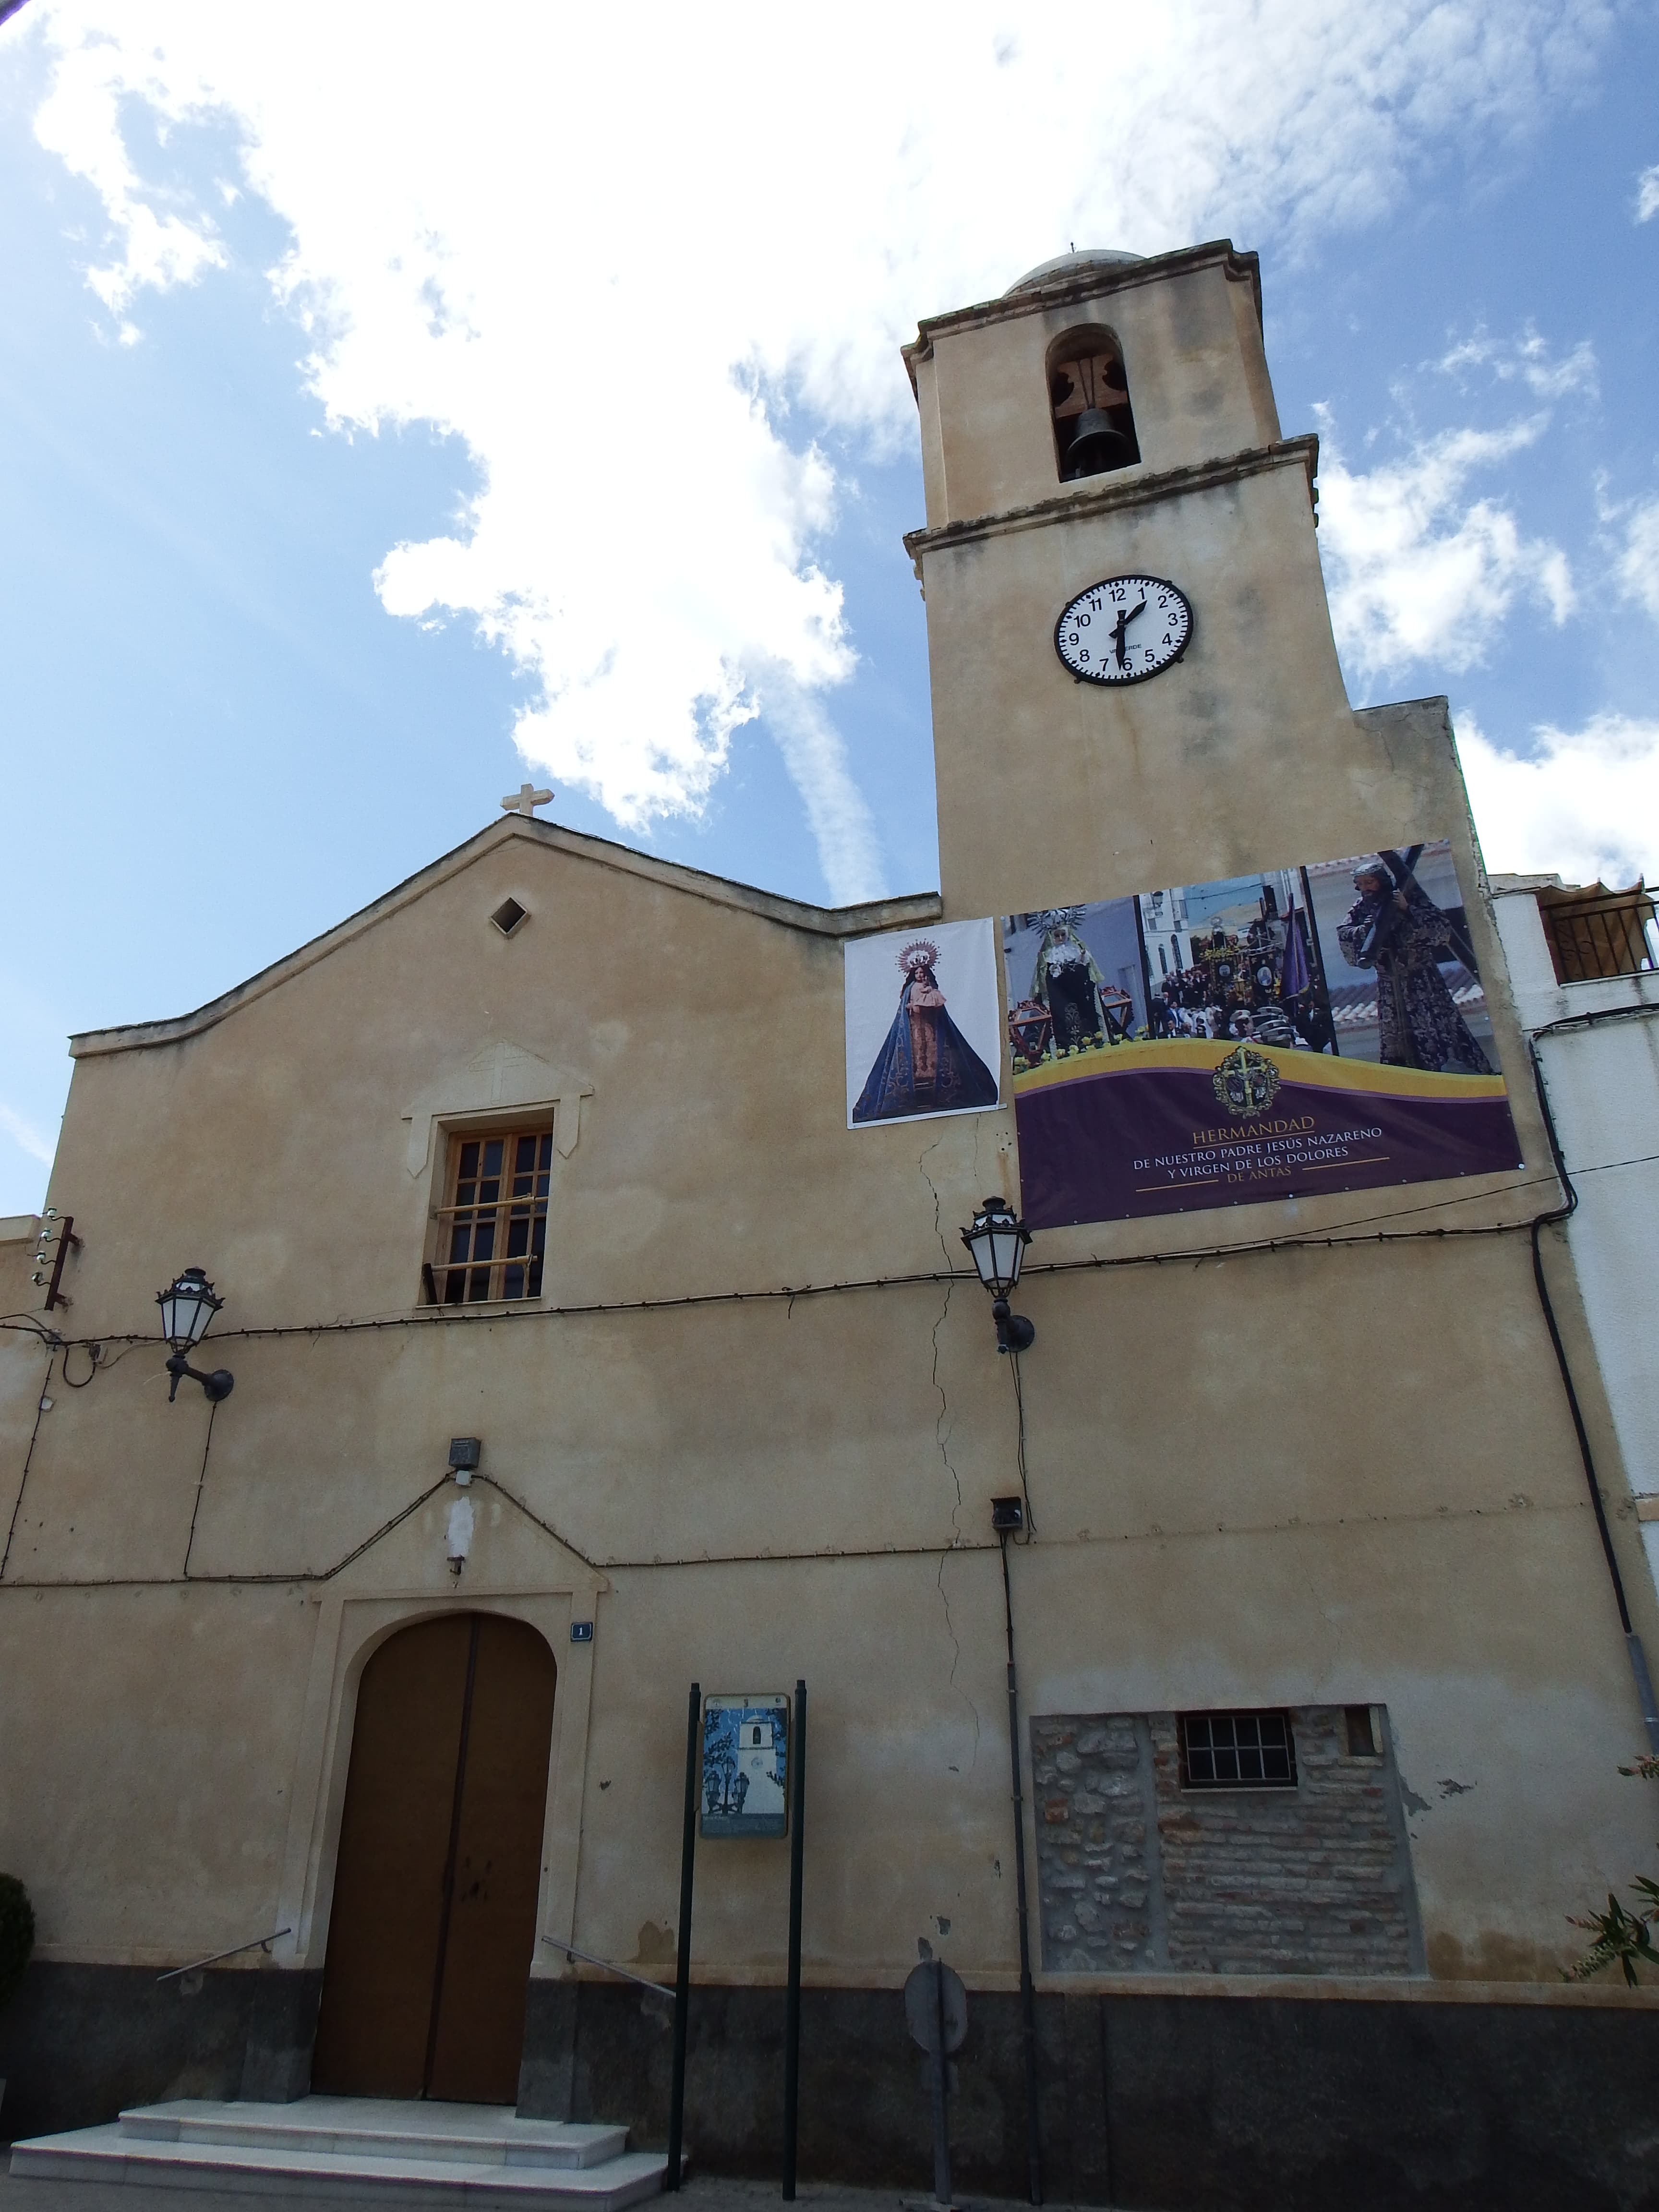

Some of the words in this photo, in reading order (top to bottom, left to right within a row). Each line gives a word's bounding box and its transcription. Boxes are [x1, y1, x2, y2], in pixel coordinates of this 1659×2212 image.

[1109, 588, 1126, 602] 12
[1138, 587, 1145, 600] 1
[1089, 598, 1102, 611] 11
[1158, 595, 1168, 608] 2
[1074, 614, 1091, 627] 10
[1168, 613, 1178, 626] 3
[1069, 633, 1079, 645] 9
[1162, 633, 1172, 645] 4
[1080, 649, 1090, 662] 8
[1109, 644, 1142, 654] VAERDE
[1145, 649, 1155, 662] 5
[1099, 659, 1108, 671] 7
[1122, 658, 1132, 671] 6
[1193, 1116, 1315, 1144] HERMANDAD
[1133, 1159, 1151, 1170] DE
[1155, 1151, 1215, 1167] NUESTRO
[1221, 1143, 1262, 1158] PADRE
[1266, 1137, 1302, 1153] JESÚS
[1307, 1127, 1382, 1147] NAZARENO
[1168, 1169, 1176, 1179] Y
[1180, 1162, 1230, 1178] VIRGEN
[1235, 1160, 1252, 1171] DE
[1257, 1155, 1281, 1168] LOS
[1286, 1146, 1348, 1164] DOLORES
[1227, 1172, 1244, 1183] DE
[1249, 1166, 1291, 1180] ANTAS
[579, 1627, 583, 1635] 1
